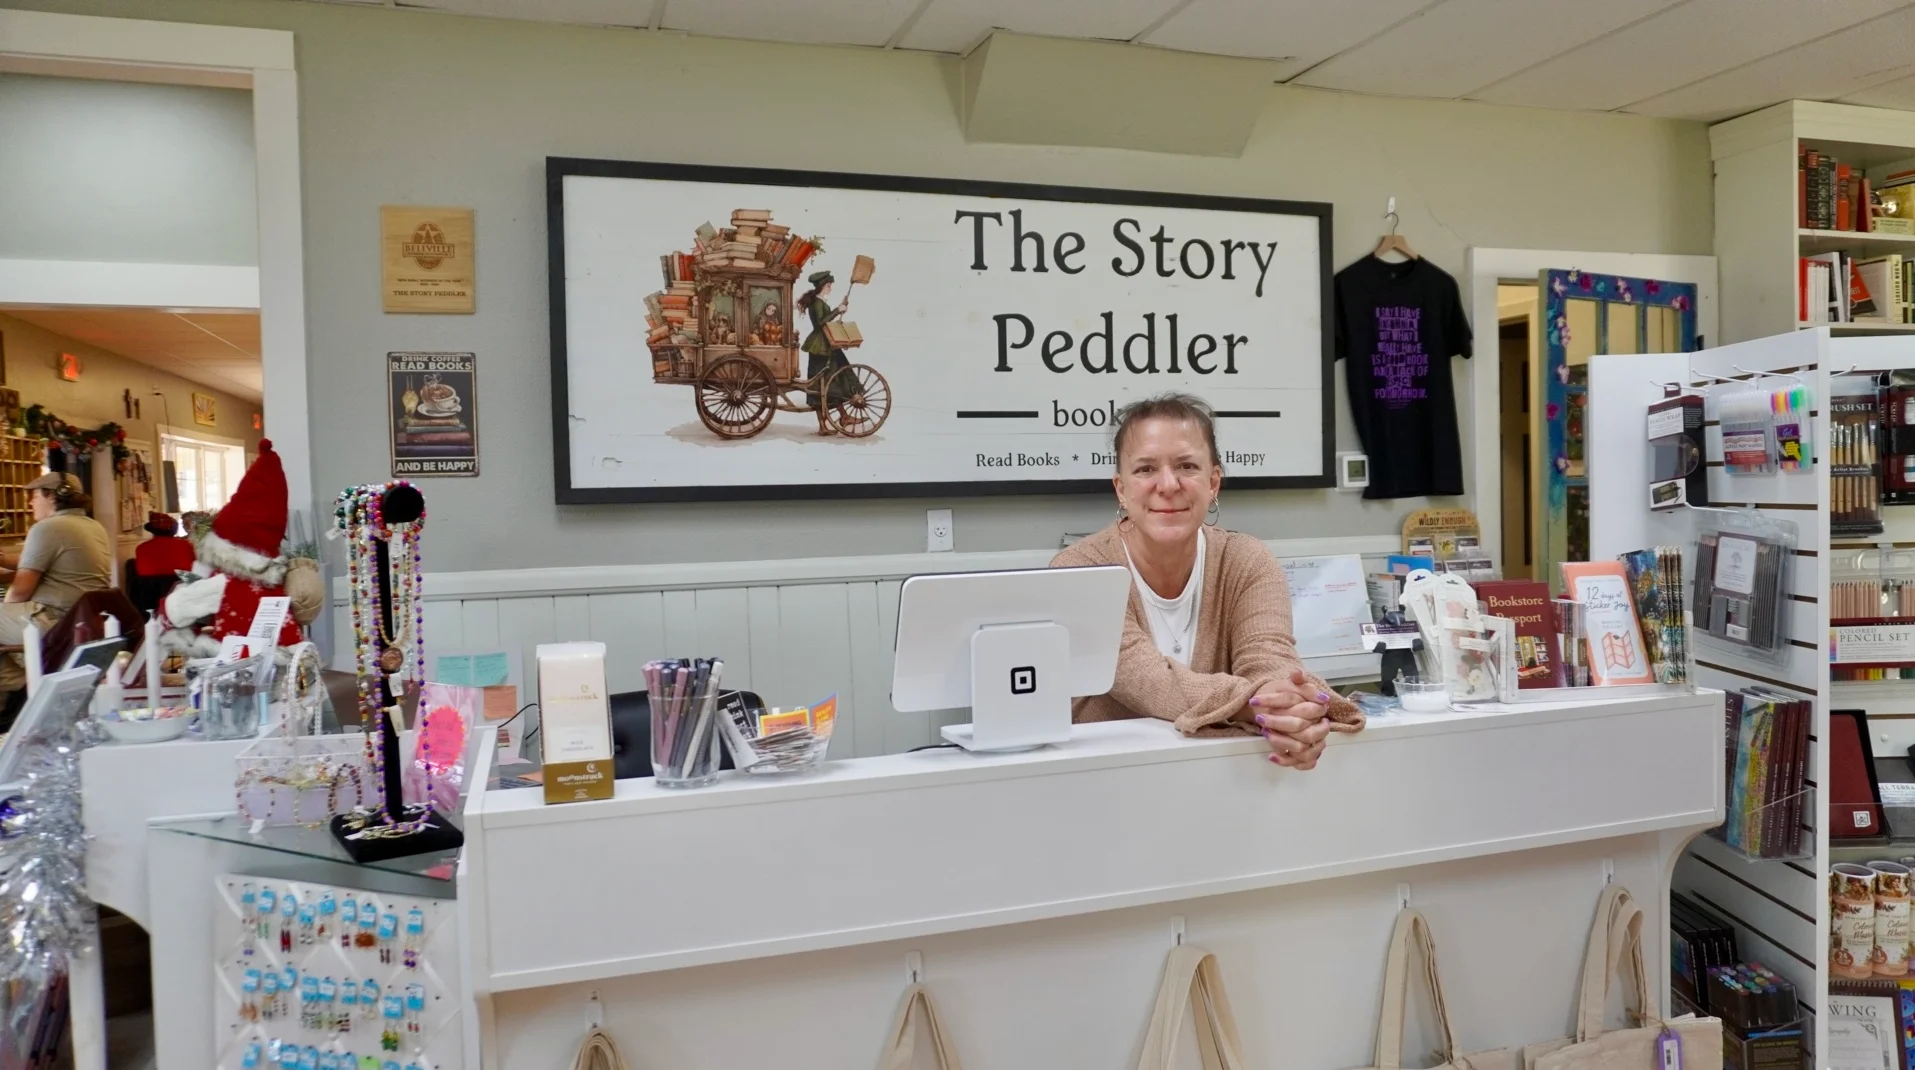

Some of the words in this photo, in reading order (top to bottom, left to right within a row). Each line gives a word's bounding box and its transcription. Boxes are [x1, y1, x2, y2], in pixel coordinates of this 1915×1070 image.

[953, 208, 1087, 275] The
[1111, 218, 1278, 298] Story
[992, 310, 1249, 375] Peddler
[392, 361, 425, 370] READ
[428, 361, 472, 370] BOOKS
[1830, 403, 1854, 412] RUSH
[1855, 402, 1874, 411] SET
[976, 453, 1013, 467] Read
[1017, 452, 1060, 467] Books
[1225, 450, 1266, 466] Happy
[396, 462, 421, 471] AND
[422, 461, 437, 471] BE
[437, 461, 475, 471] HAPPY
[1418, 517, 1440, 526] WILDLY
[1441, 516, 1467, 525] ENOUGH
[1586, 586, 1599, 600] 12
[1488, 595, 1544, 608] Bookstore
[1613, 601, 1630, 612] Joy
[1496, 611, 1543, 628] Psport
[1840, 633, 1885, 643] PENCIL
[1888, 632, 1911, 641] SET
[557, 772, 604, 783] moonstruck
[1828, 1004, 1877, 1017] WING
